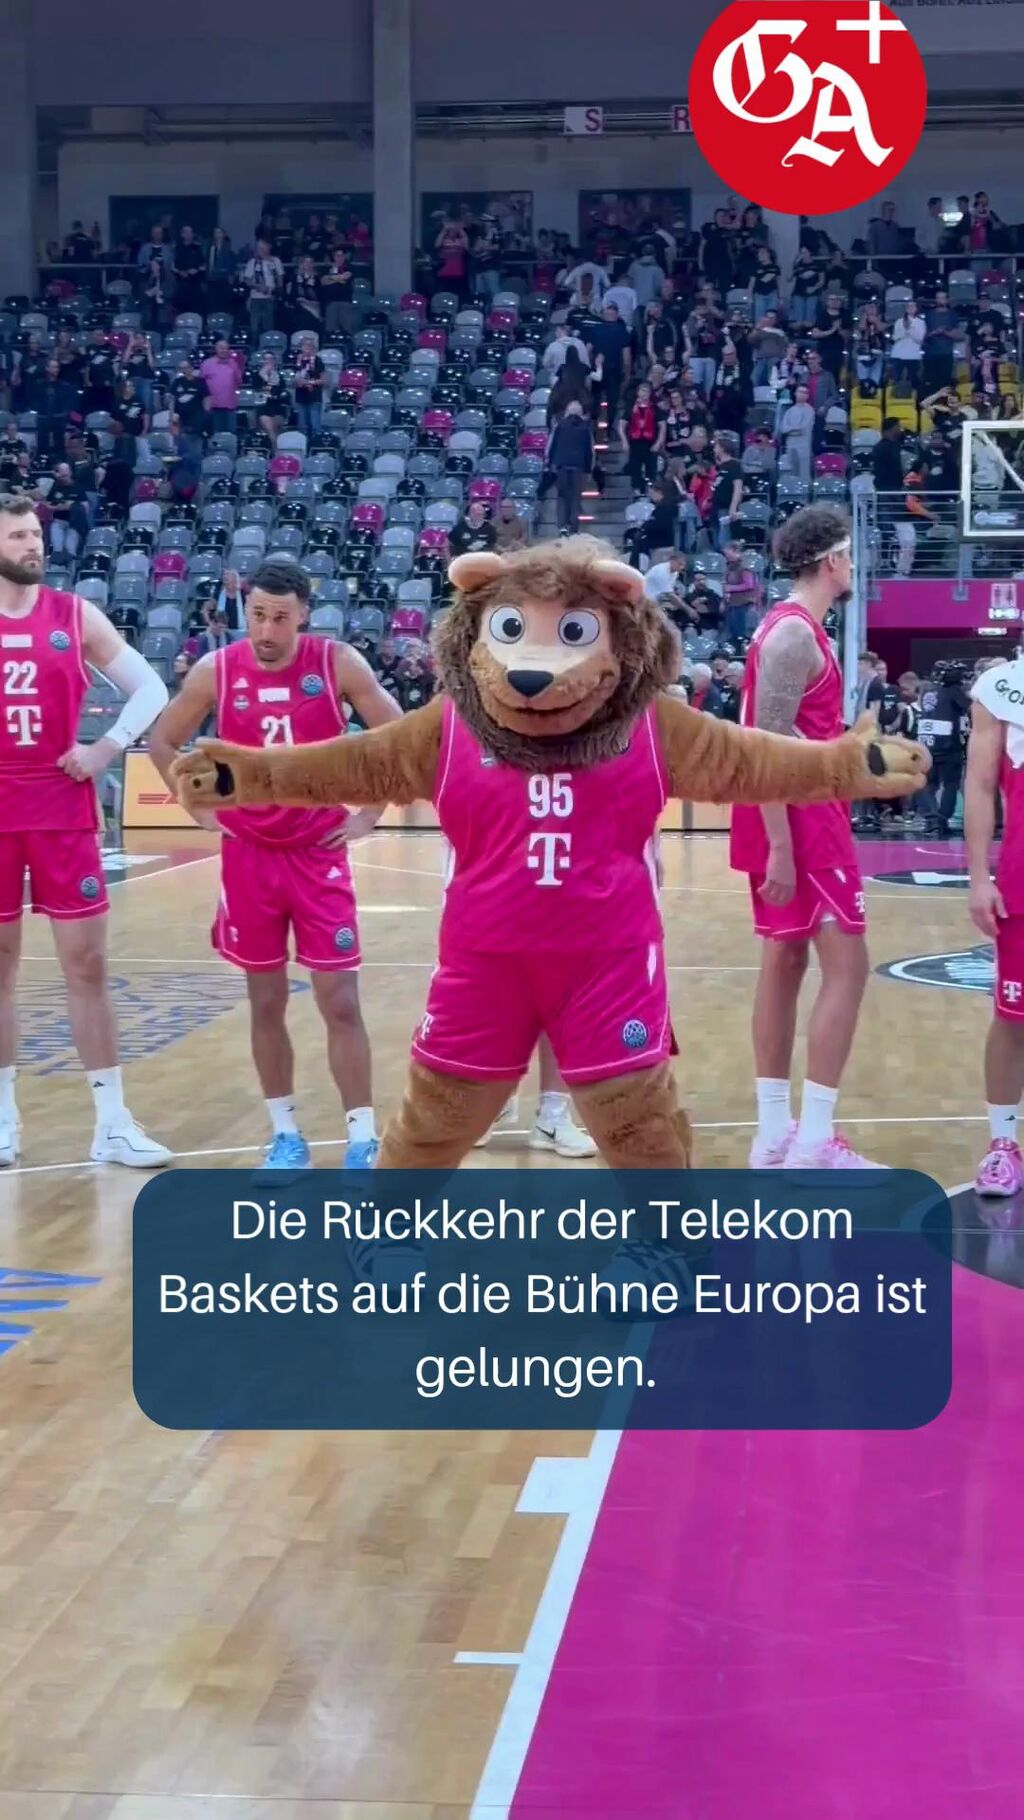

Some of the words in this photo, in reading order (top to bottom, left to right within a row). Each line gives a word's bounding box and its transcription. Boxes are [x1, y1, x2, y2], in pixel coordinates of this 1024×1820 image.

[585, 108, 600, 132] S
[673, 106, 690, 130] R
[3, 660, 39, 695] 22
[260, 714, 295, 749] 21
[528, 772, 575, 818] 95
